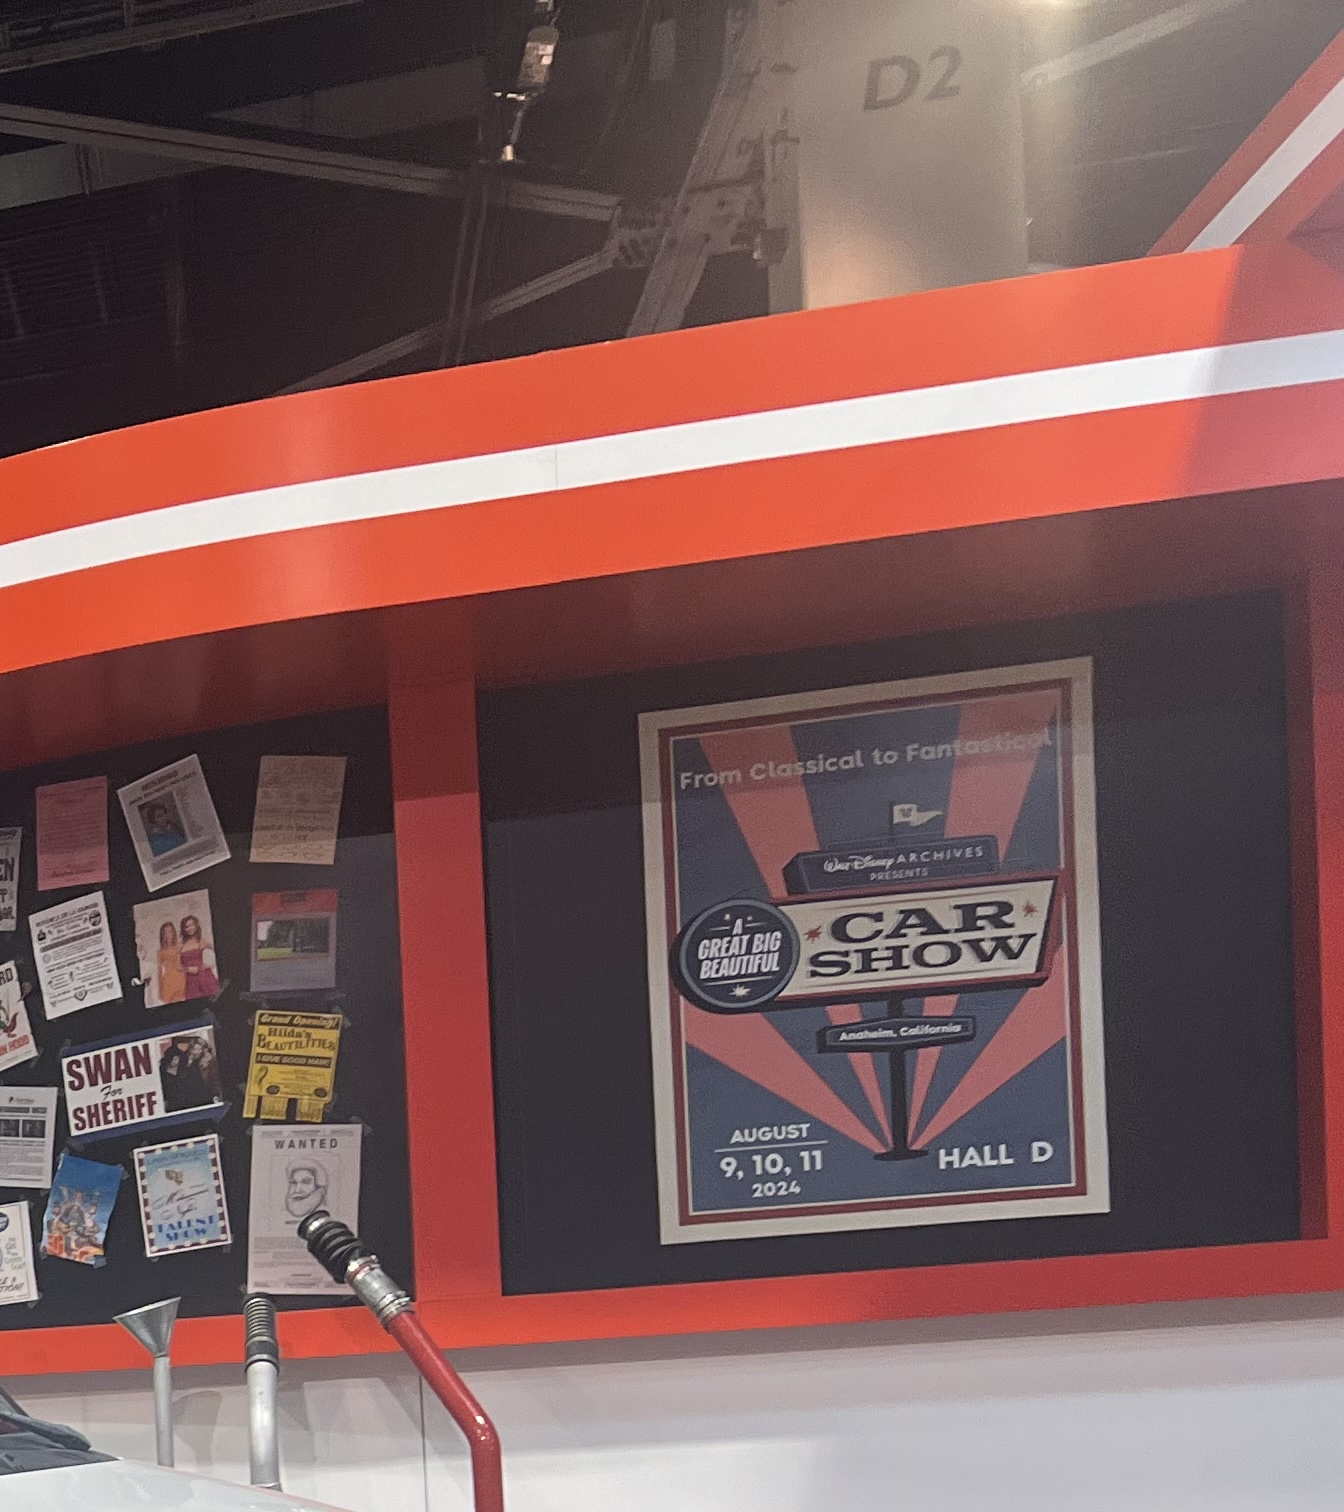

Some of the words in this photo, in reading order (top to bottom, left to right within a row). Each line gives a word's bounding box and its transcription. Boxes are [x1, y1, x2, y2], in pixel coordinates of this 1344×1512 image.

[864, 44, 962, 110] D2
[680, 768, 742, 790] From
[749, 750, 864, 781] Classical
[871, 748, 899, 765] to
[896, 845, 984, 864] ARCHIVES
[870, 868, 929, 881] PRESENTS
[731, 918, 744, 936] A
[830, 900, 1016, 945] CAR
[697, 934, 751, 960] GREAT
[752, 931, 782, 953] BIG
[809, 933, 1038, 978] SHOW
[699, 952, 781, 980] BEAUTIFUL
[838, 1027, 898, 1042] Anaheim,
[899, 1023, 963, 1037] California
[66, 1043, 153, 1092] SWAN
[100, 1084, 123, 1101] For
[72, 1091, 158, 1132] SHERIFF
[274, 1138, 338, 1150] WANTED
[730, 1123, 811, 1144] AUGUST
[719, 1157, 744, 1180] 9,
[752, 1153, 792, 1176] 10,
[799, 1150, 823, 1171] 11
[938, 1143, 1015, 1169] HALL
[1031, 1141, 1054, 1162] D
[752, 1180, 801, 1198] 2024
